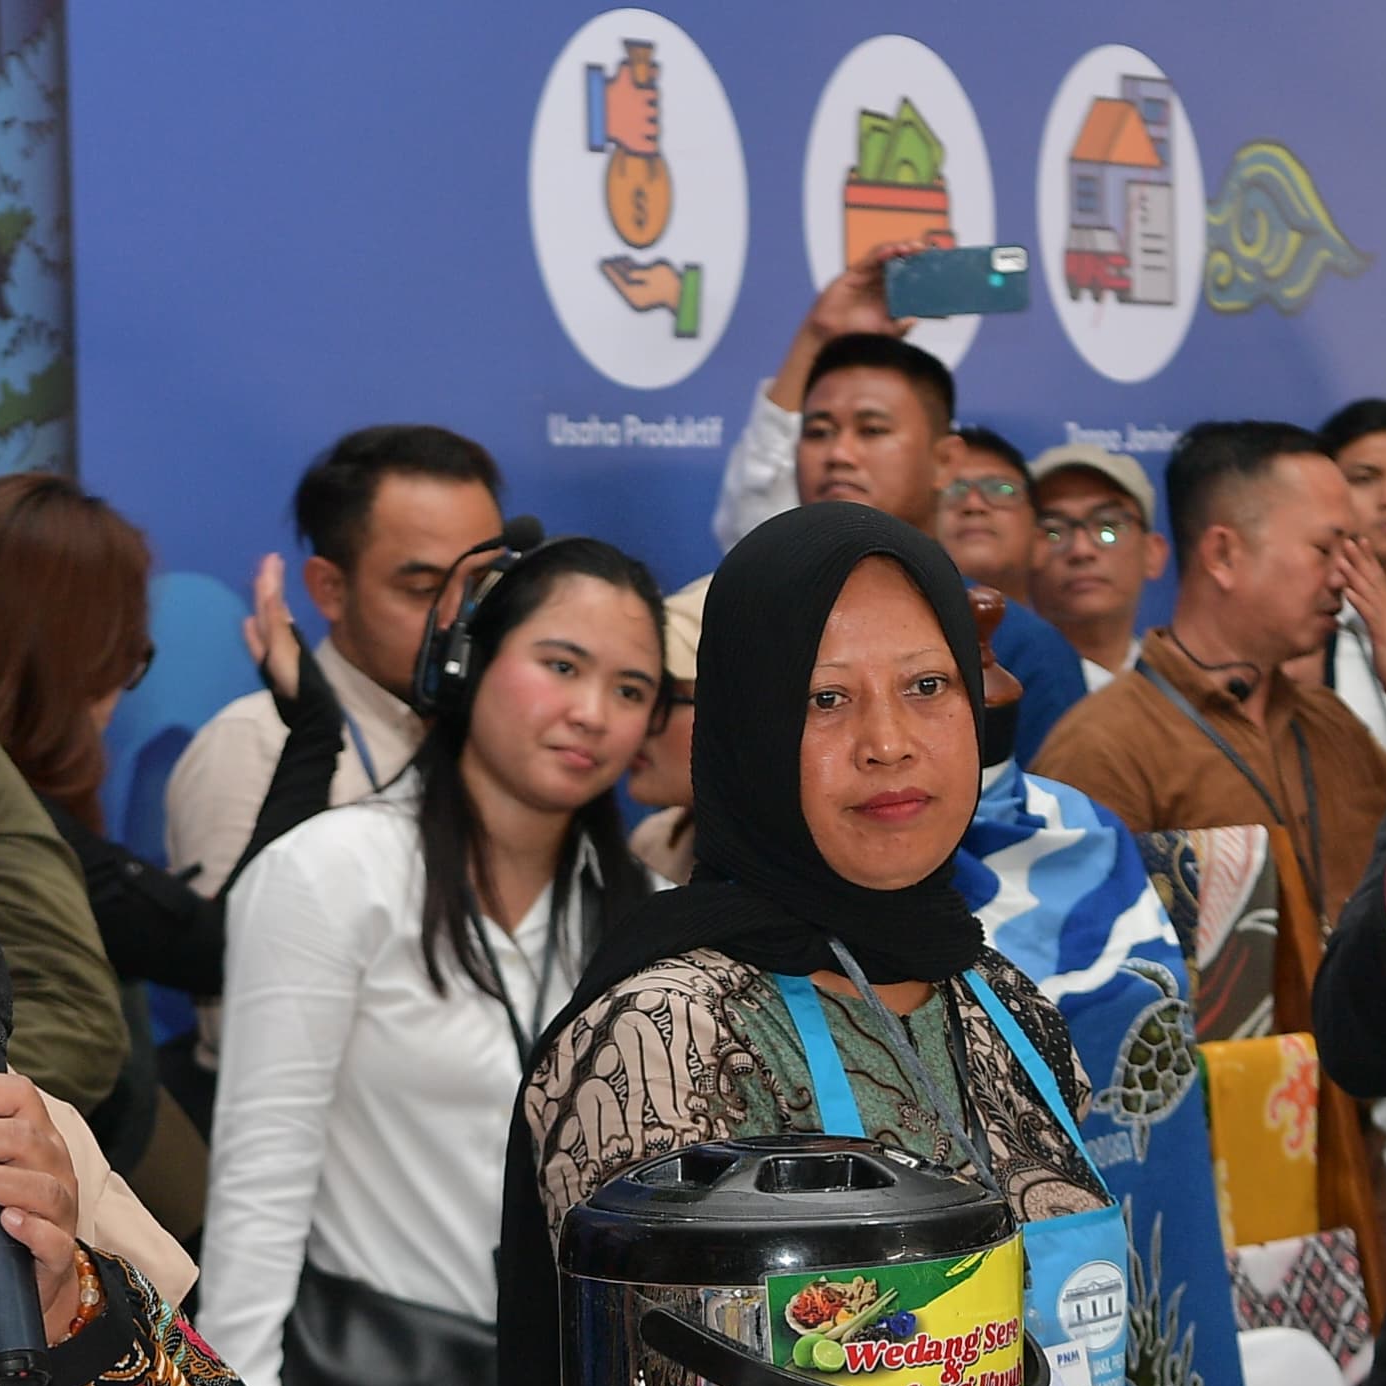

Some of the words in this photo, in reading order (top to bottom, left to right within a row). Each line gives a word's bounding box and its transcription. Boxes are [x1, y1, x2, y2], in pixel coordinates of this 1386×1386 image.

[547, 414, 620, 447] Usaha
[623, 414, 724, 447] Produktif
[845, 1326, 981, 1373] Wedang
[984, 1317, 1019, 1351] Sere
[1056, 1351, 1080, 1366] PNM
[940, 1357, 964, 1385] &
